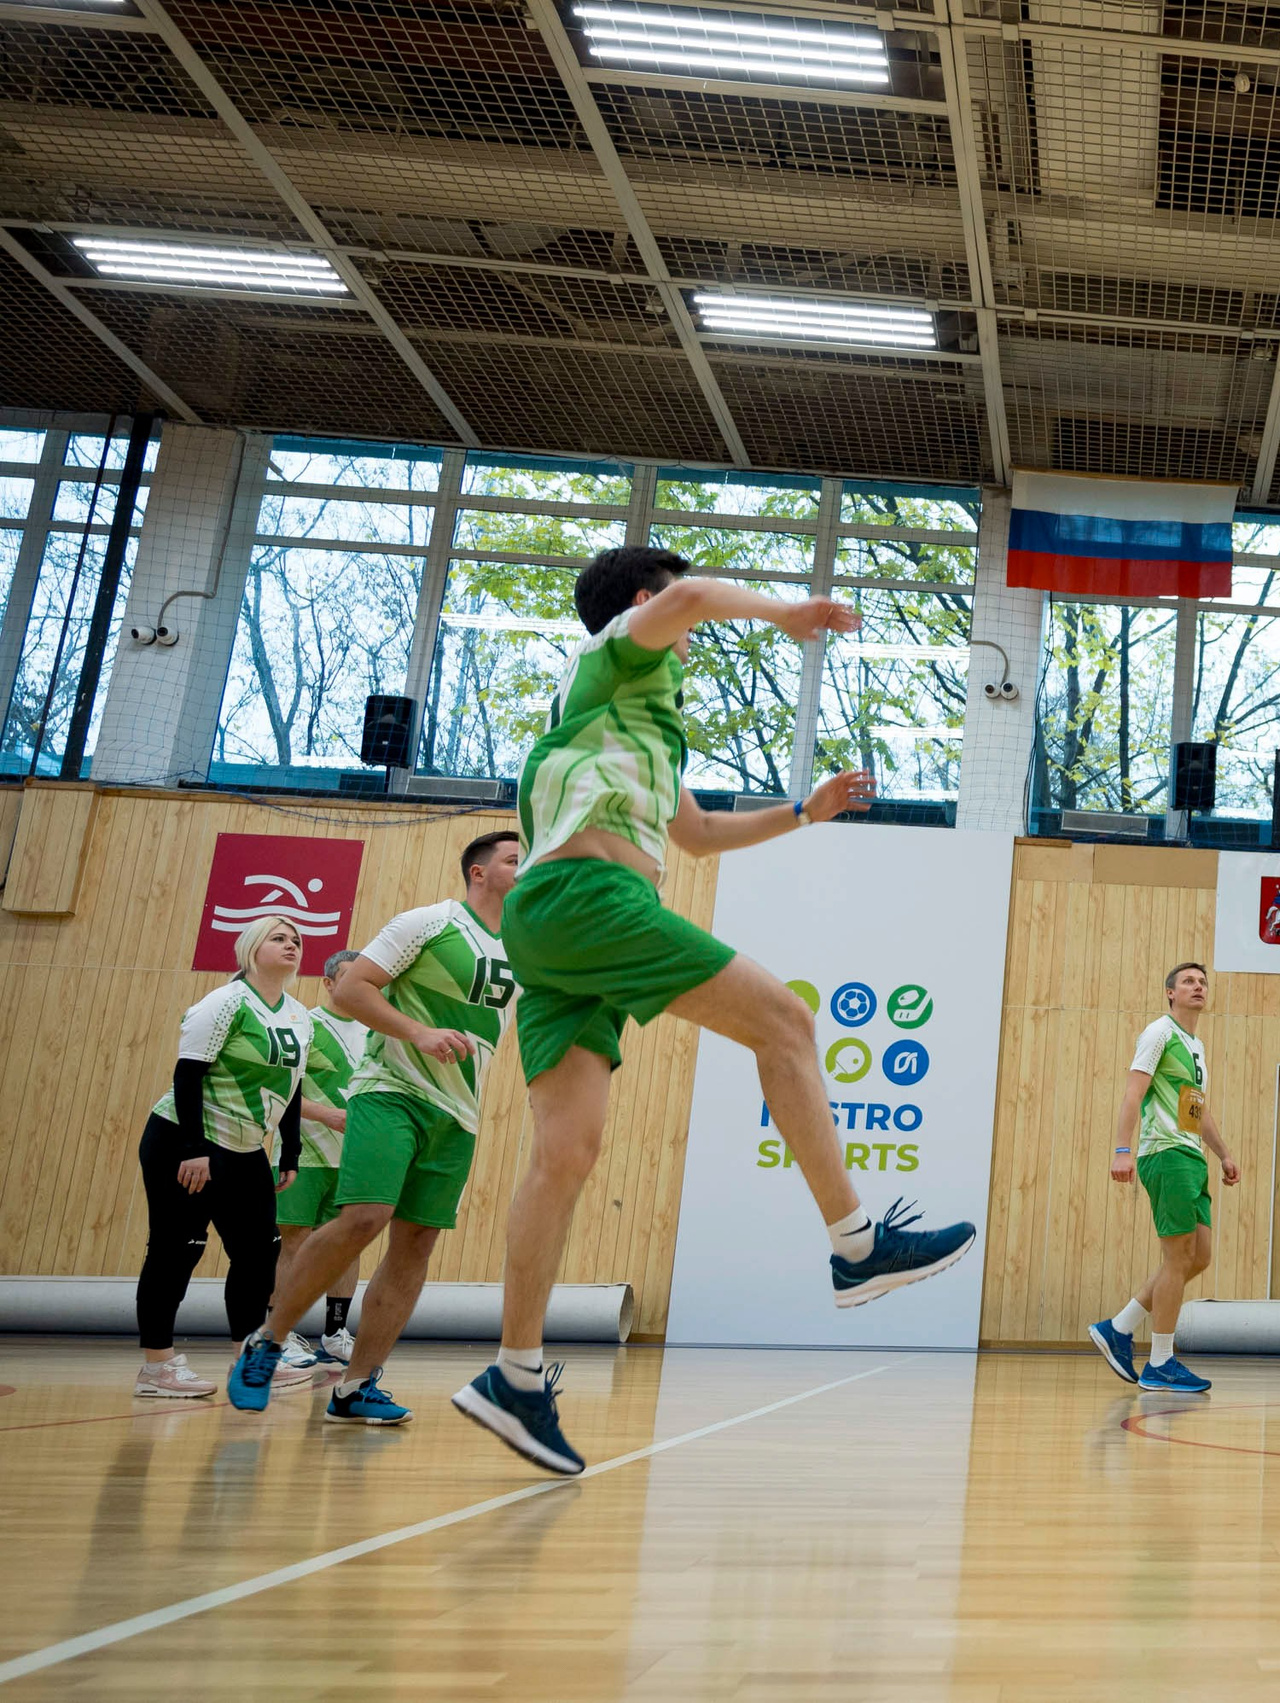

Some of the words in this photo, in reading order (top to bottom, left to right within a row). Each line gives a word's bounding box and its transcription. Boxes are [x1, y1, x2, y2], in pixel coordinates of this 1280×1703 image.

[468, 956, 516, 1009] 15
[265, 1026, 301, 1068] 19
[1192, 1052, 1203, 1086] 6
